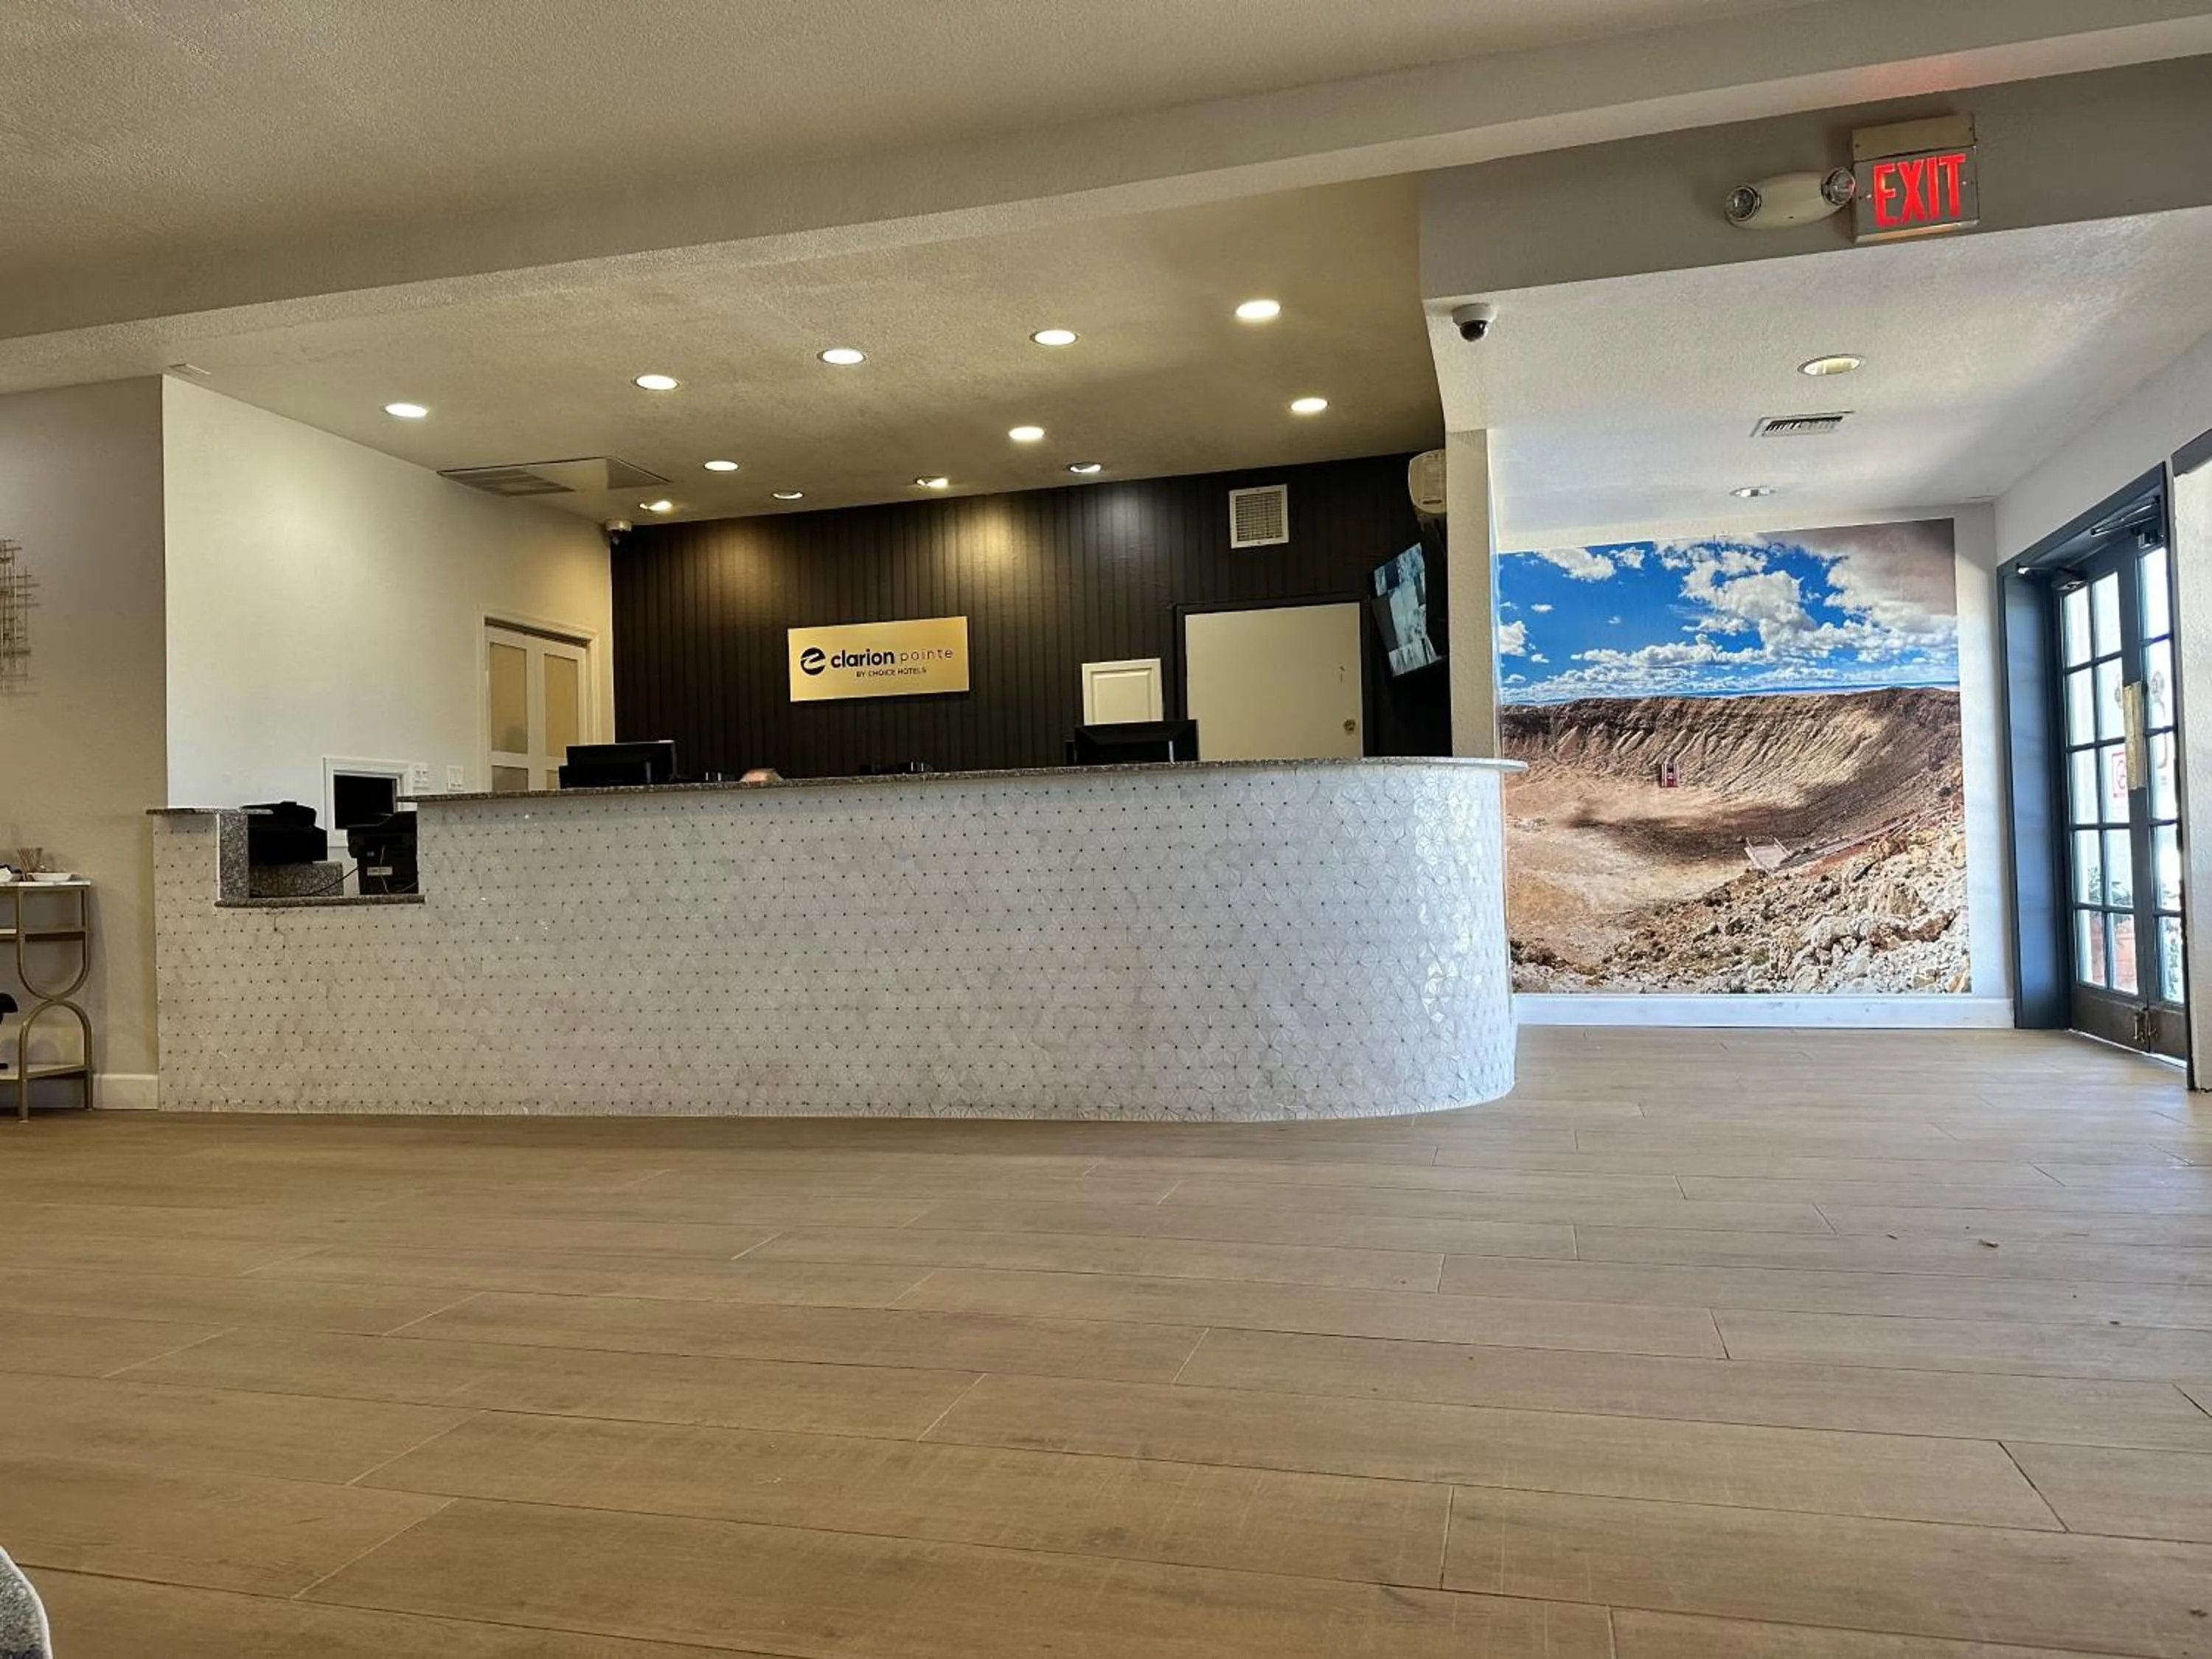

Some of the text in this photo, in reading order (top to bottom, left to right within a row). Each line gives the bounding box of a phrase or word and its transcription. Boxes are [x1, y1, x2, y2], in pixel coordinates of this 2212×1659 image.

[1873, 153, 1966, 228] EXIT
[830, 649, 953, 668] clarion pointe
[868, 669, 896, 677] CHOICE
[897, 667, 927, 675] HOTELS
